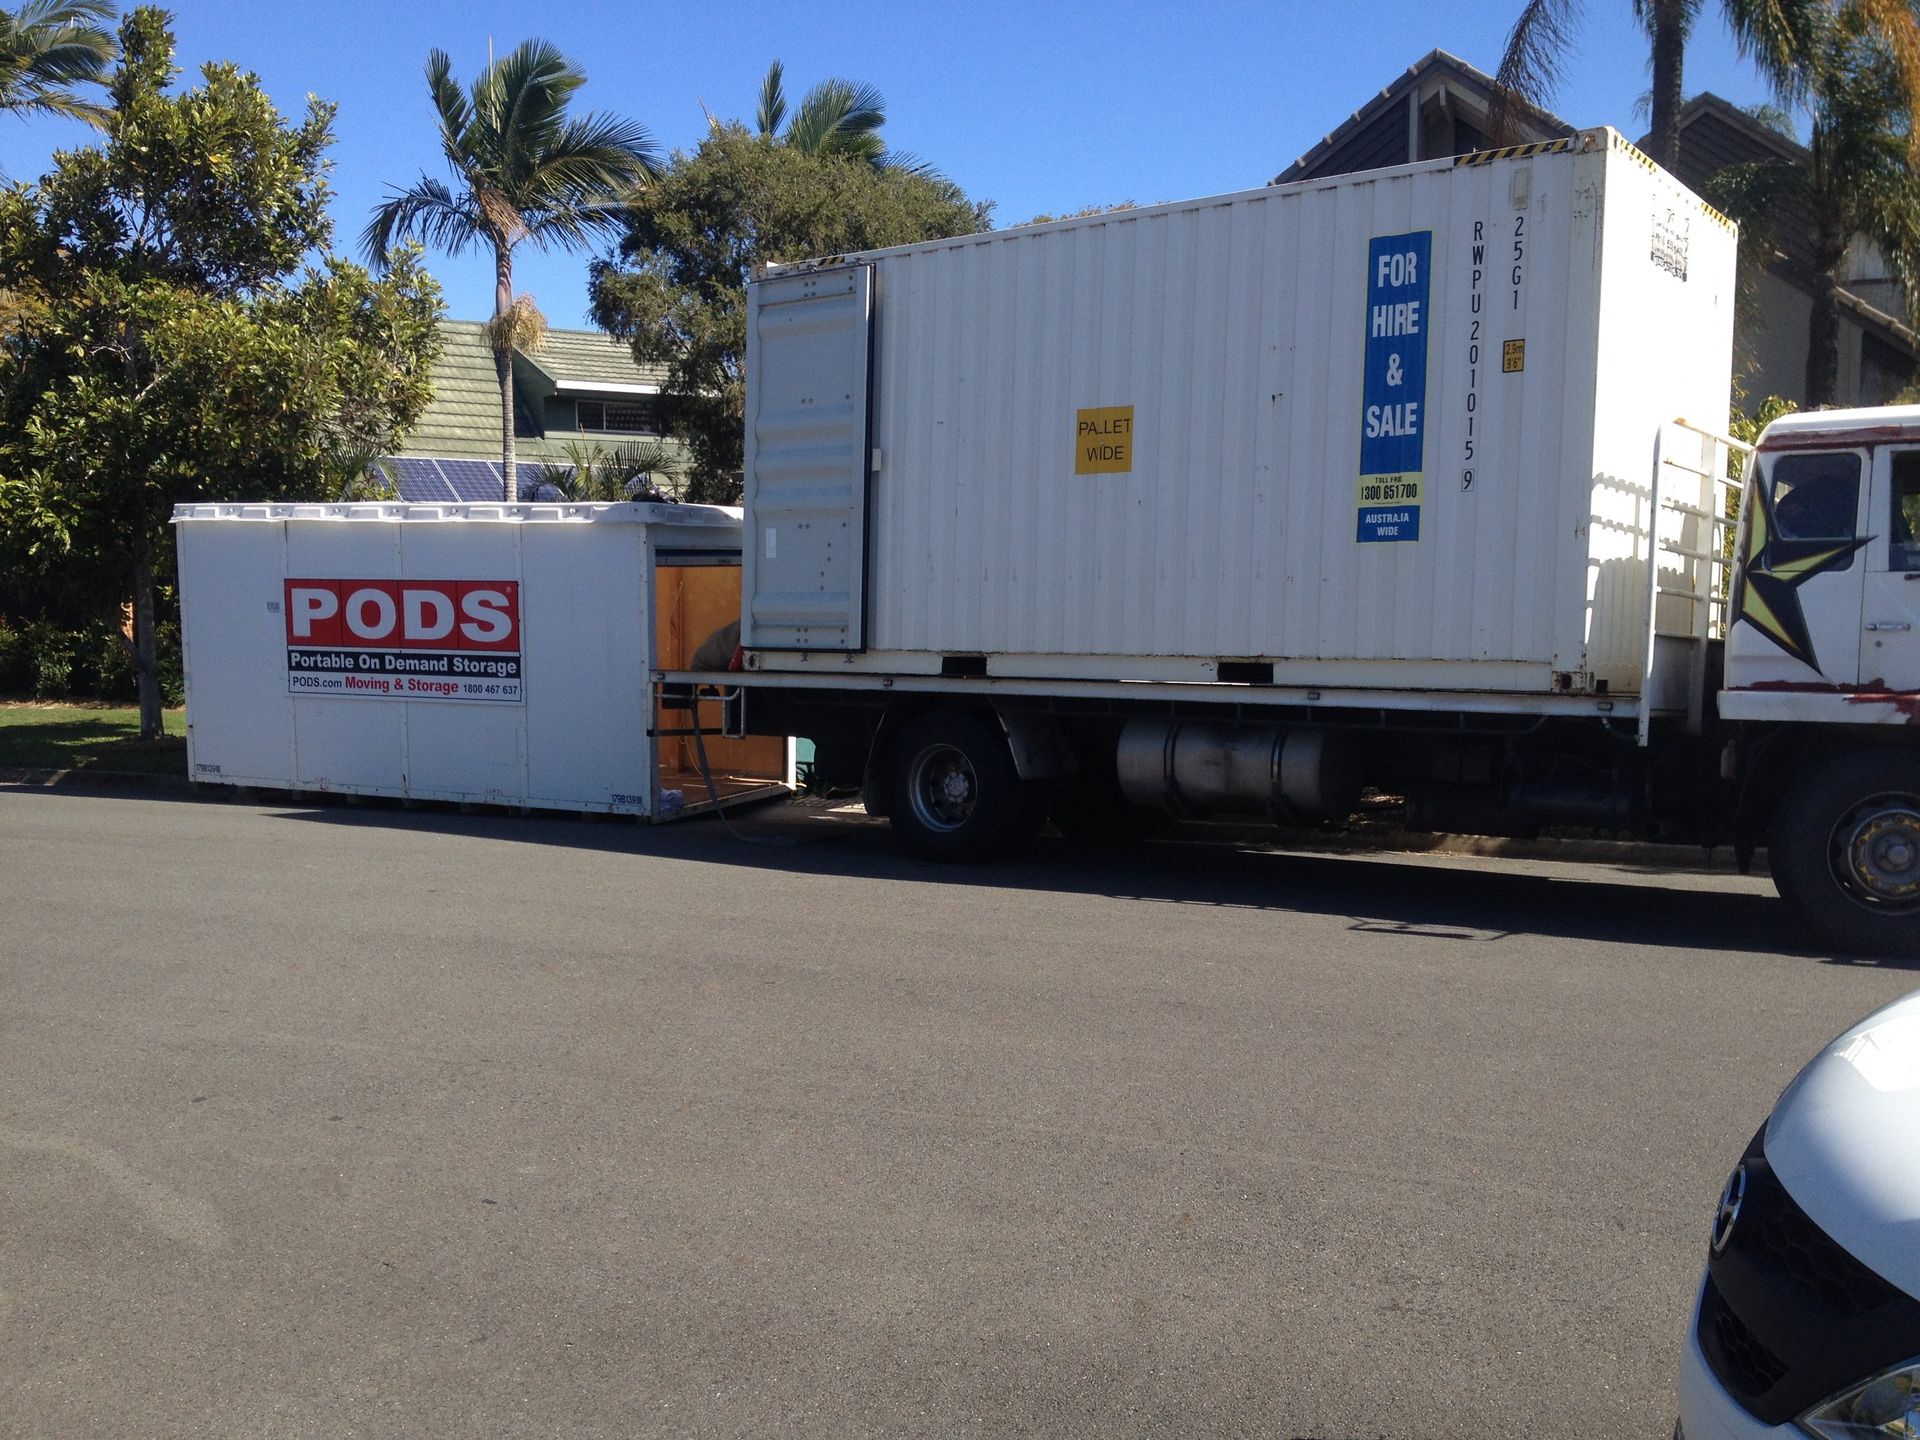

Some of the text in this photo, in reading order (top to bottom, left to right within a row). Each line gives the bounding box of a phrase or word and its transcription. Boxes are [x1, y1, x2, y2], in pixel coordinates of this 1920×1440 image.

[1377, 251, 1418, 288] FOR
[1512, 216, 1525, 310] 25G1
[1372, 301, 1420, 338] HIRE
[1386, 353, 1404, 387] &
[1366, 402, 1418, 439] SALE
[1087, 446, 1124, 462] WIDE
[1377, 526, 1399, 536] WIDE
[290, 588, 513, 643] PODS
[290, 652, 518, 677] Portable On Demand Storage
[292, 676, 518, 695] PODS.com Moving & Storage 1800 467 637
